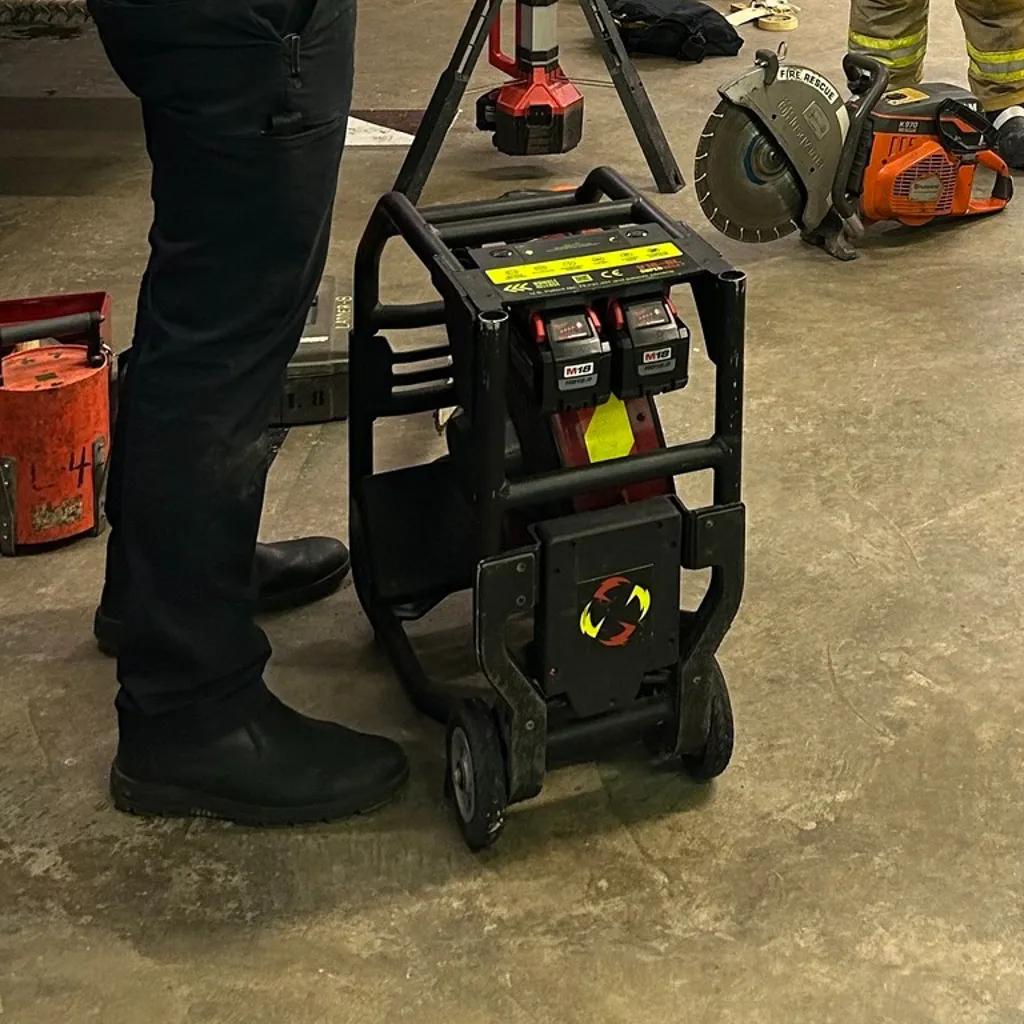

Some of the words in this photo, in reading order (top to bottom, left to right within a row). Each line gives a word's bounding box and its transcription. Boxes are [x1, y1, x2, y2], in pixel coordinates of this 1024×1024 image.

[780, 70, 801, 79] FIRE
[804, 73, 836, 102] RESCUE
[645, 349, 670, 362] M18
[566, 363, 592, 376] M18
